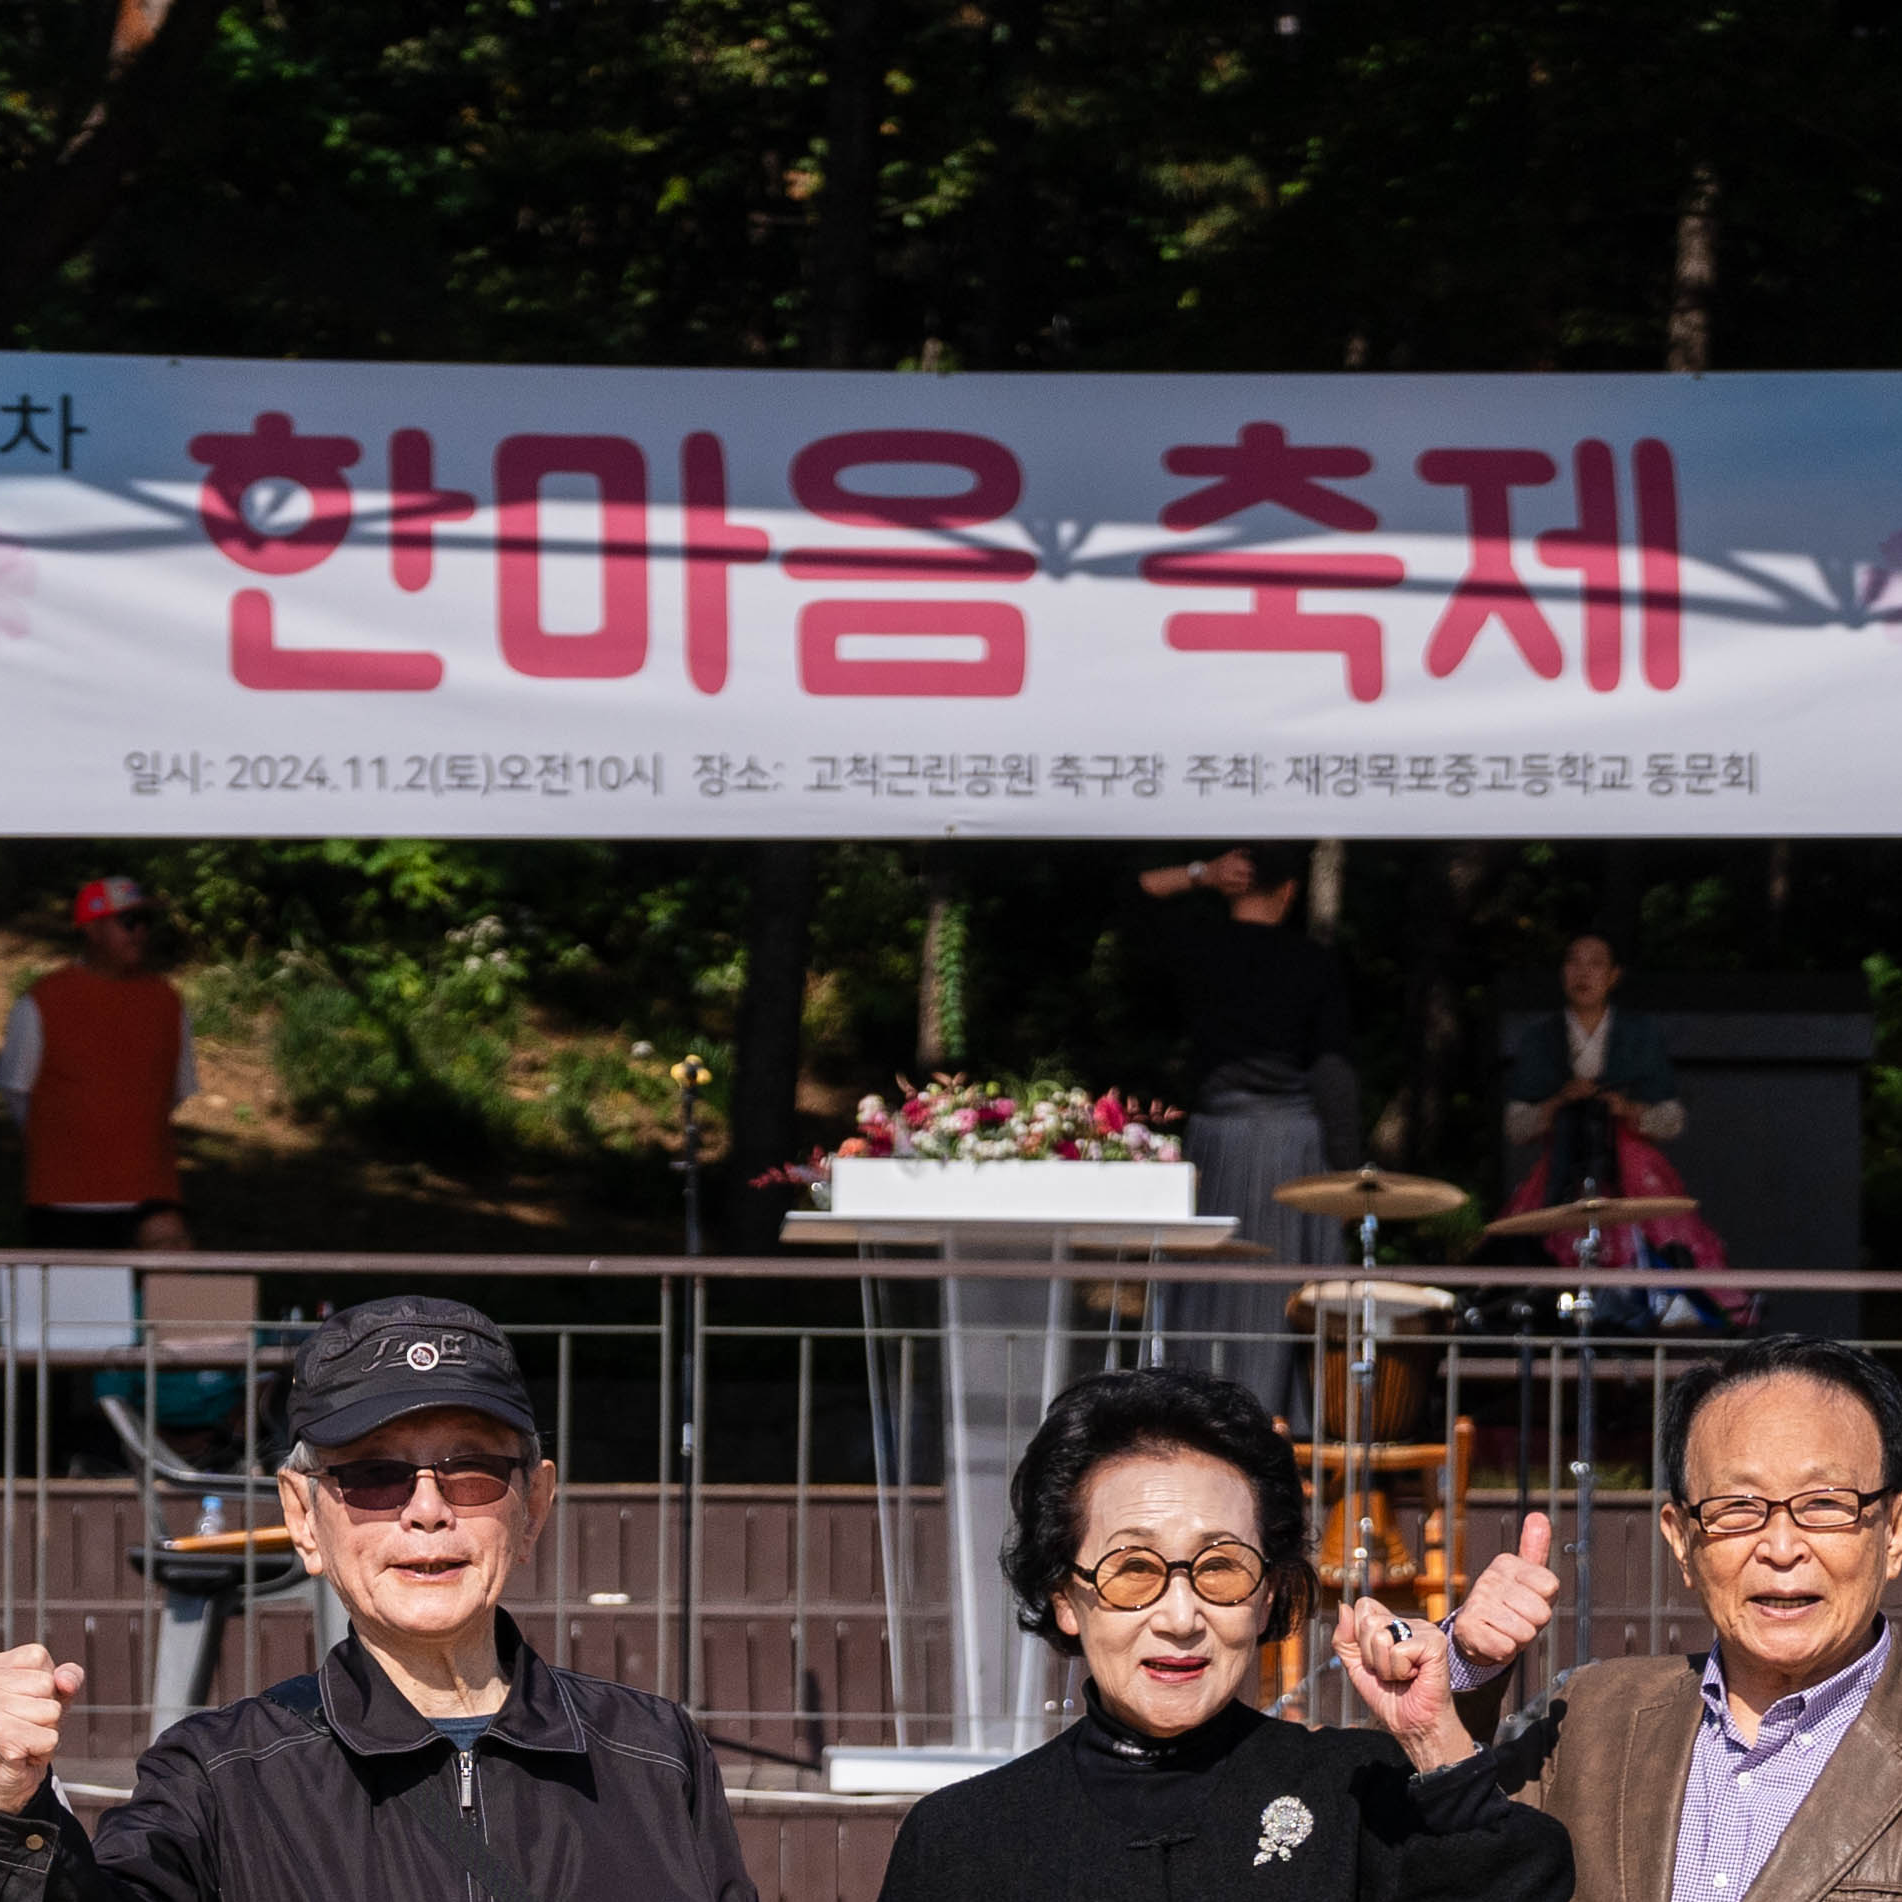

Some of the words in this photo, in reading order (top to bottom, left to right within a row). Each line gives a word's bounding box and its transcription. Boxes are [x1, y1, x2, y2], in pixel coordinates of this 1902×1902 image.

[187, 409, 1038, 698] 한마음
[1138, 420, 1683, 705] 축제
[122, 750, 215, 795] 일시:
[692, 752, 785, 798] 장소:
[803, 752, 1036, 798] 고척근린공원
[1048, 752, 1165, 799] 축구장
[1183, 752, 1277, 797] 주최:
[1284, 751, 1632, 799] 재경목포중고등학교
[1643, 750, 1761, 797] 동문회
